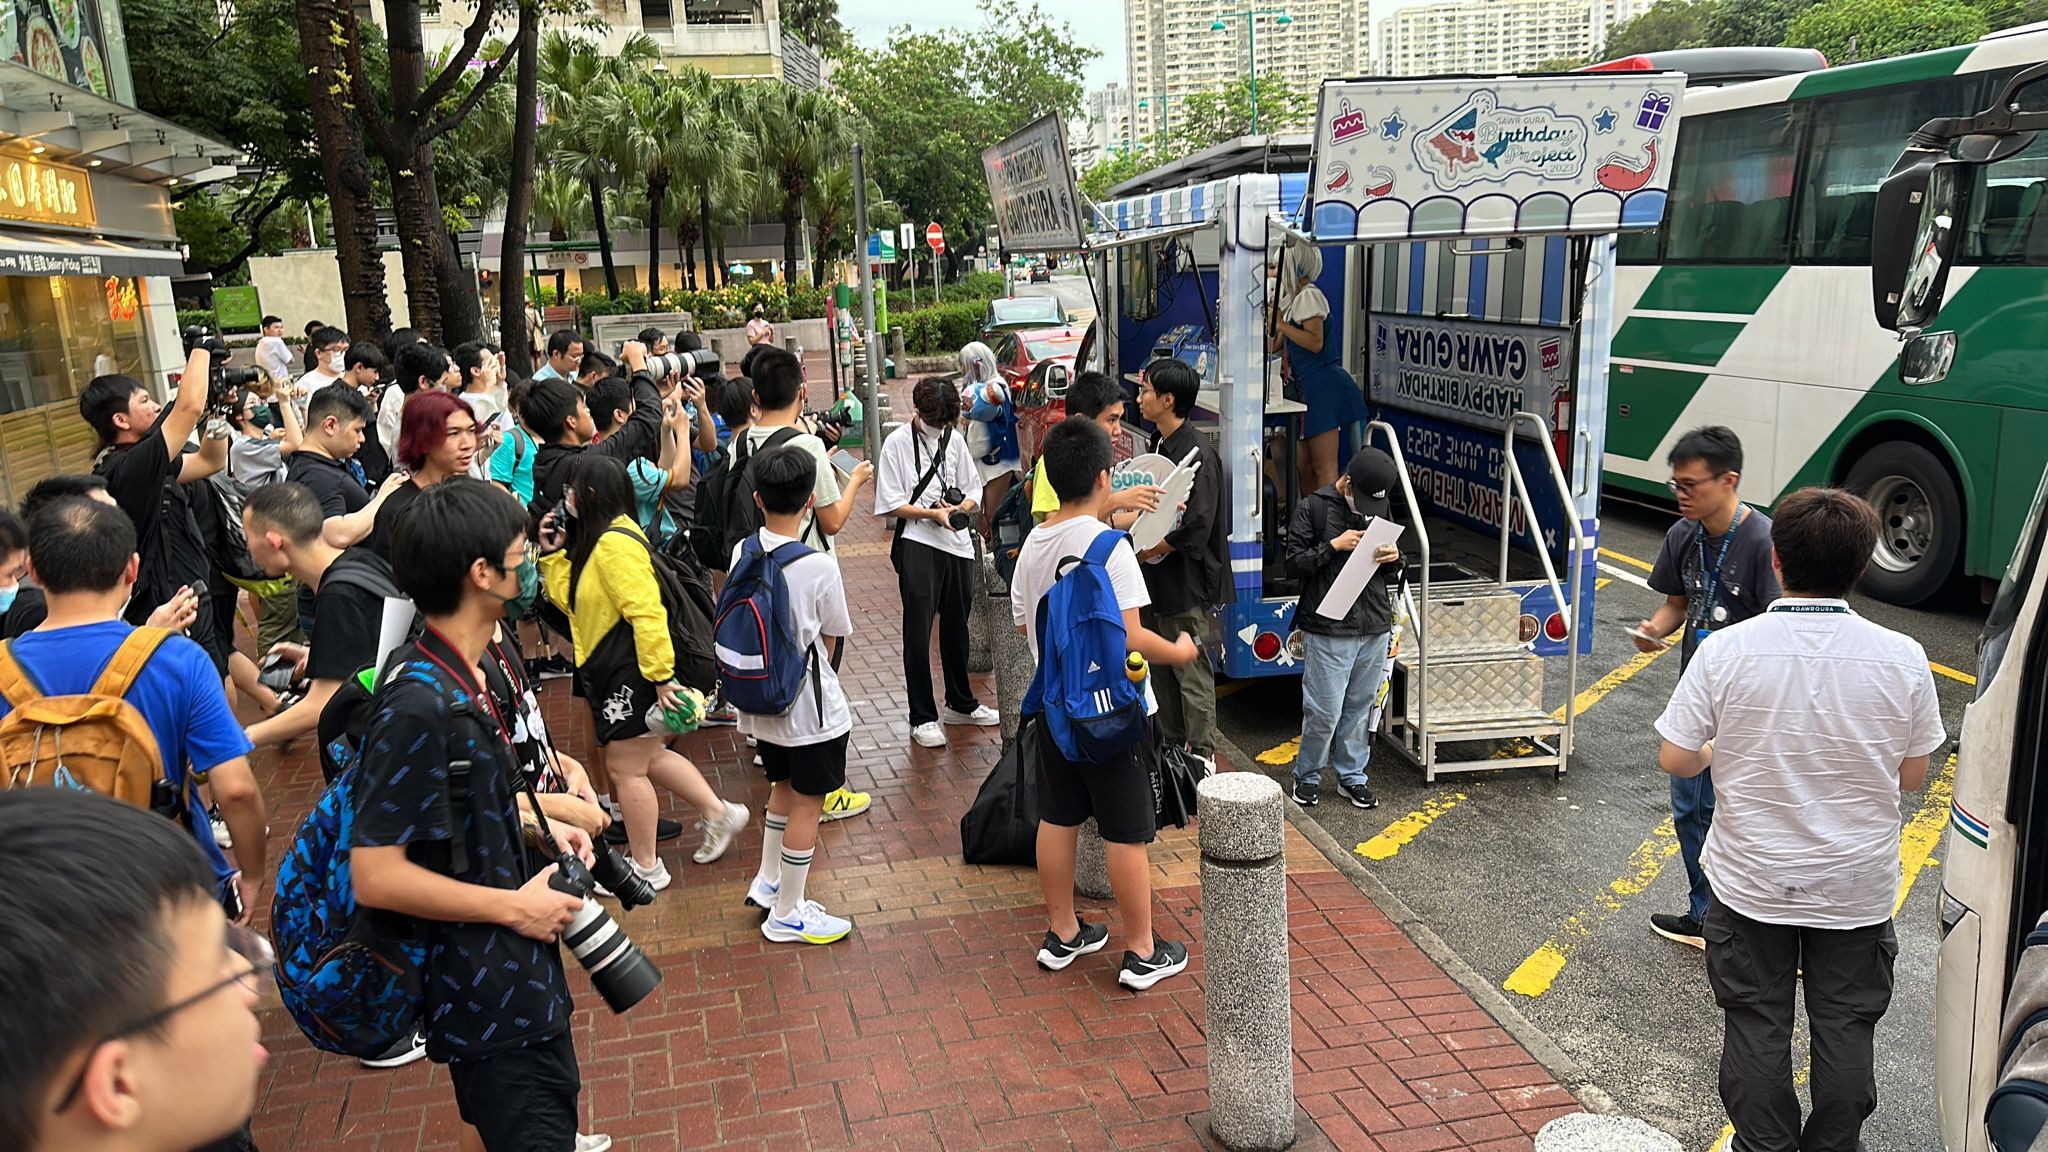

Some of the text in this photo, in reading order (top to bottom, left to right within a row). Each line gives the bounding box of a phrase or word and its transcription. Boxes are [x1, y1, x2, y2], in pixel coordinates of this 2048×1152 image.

[1478, 122, 1578, 147] Birthday
[1523, 116, 1546, 124] GURA
[1504, 144, 1577, 168] Project
[1550, 164, 1574, 173] 2023
[1004, 186, 1061, 235] GAWR GURA
[1394, 326, 1528, 382] GAWR GURA
[1397, 370, 1524, 424] HAPPY BIRTHDAY
[1406, 425, 1441, 461] 2023
[1446, 435, 1483, 472] JUNE
[1110, 470, 1156, 490] GURA
[1433, 468, 1467, 515] THE
[1468, 481, 1526, 537] MARK
[500, 659, 518, 694] Canon
